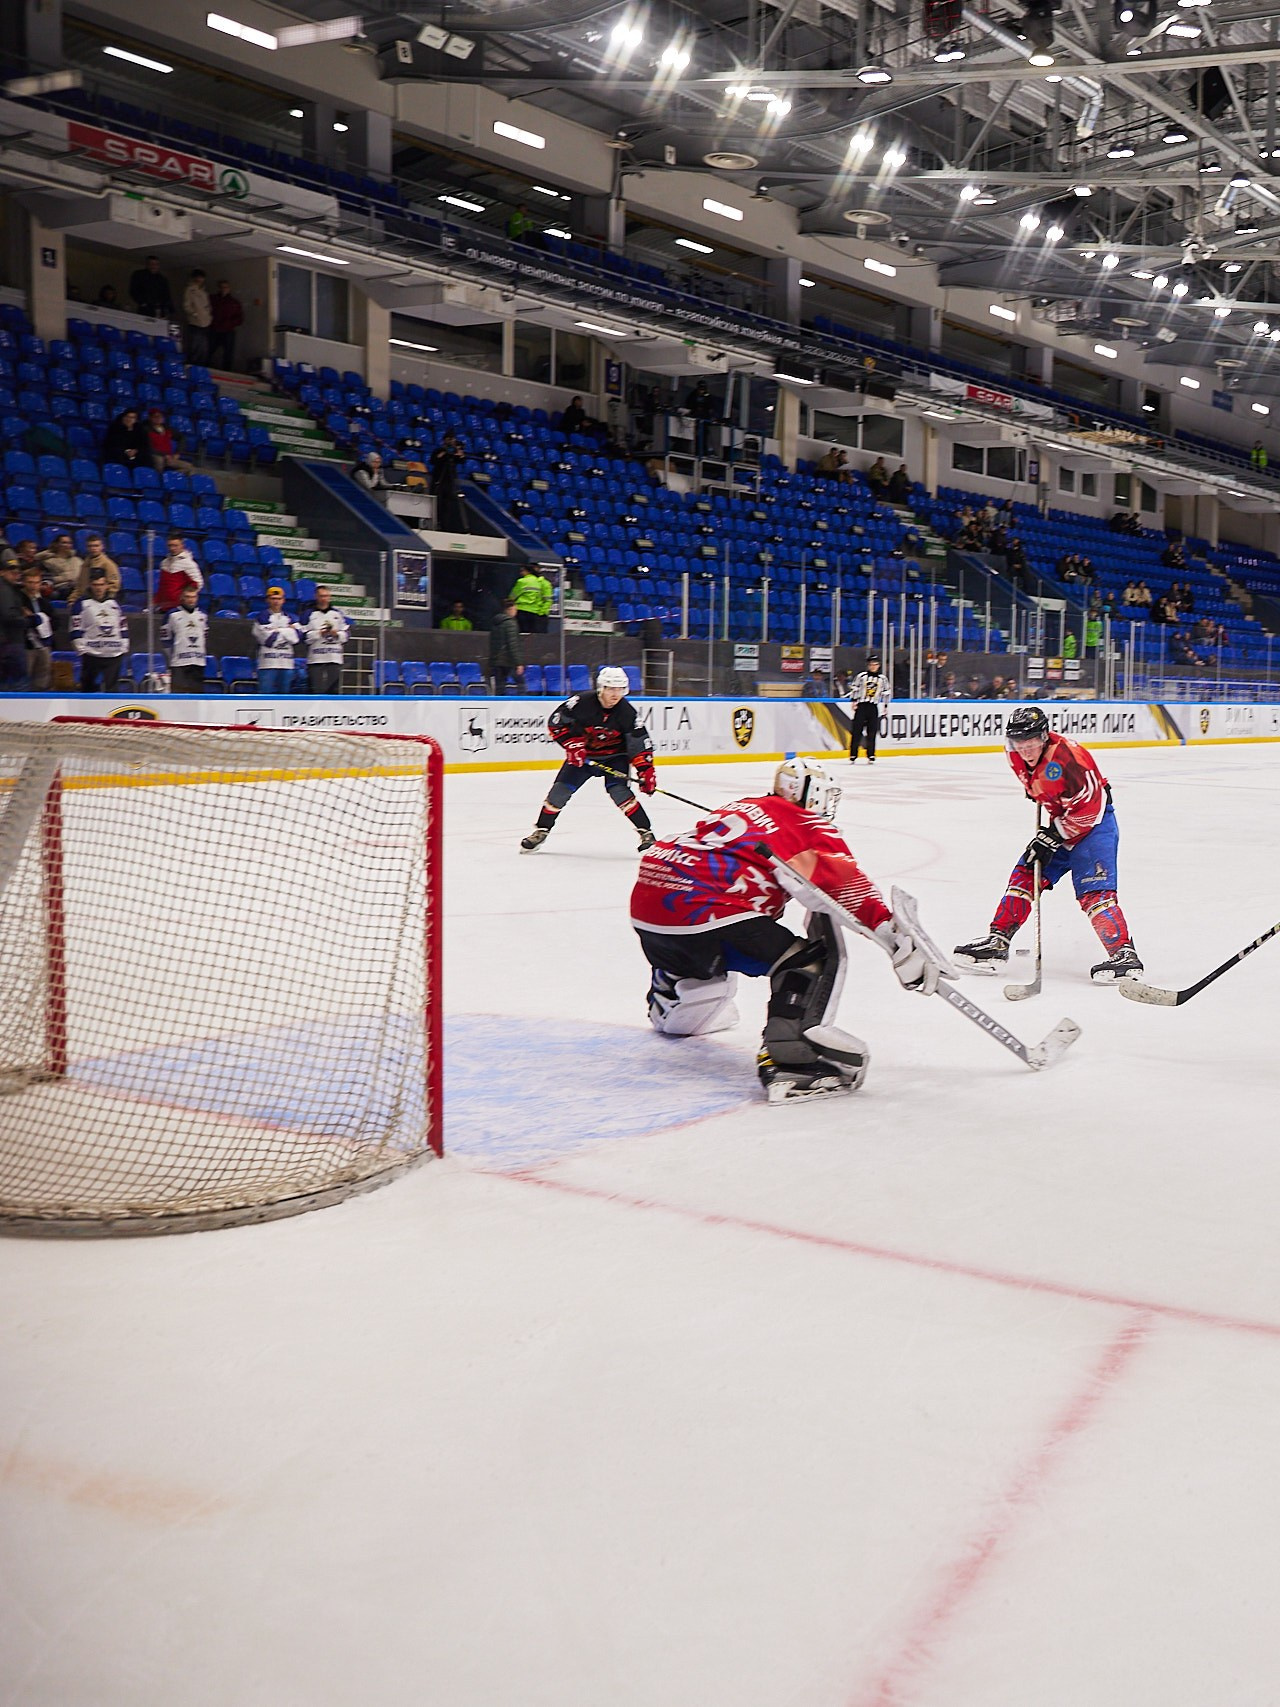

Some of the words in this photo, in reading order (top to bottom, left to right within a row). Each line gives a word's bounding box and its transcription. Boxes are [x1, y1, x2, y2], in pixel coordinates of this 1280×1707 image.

[103, 138, 215, 185] SPAR
[281, 715, 388, 727] ПРАВИТЕЛЬСТВО
[494, 715, 545, 729] НИЖНИЙ
[878, 713, 1003, 739] ОФИЦЕРСКАЯ
[1102, 713, 1136, 733] ЛИГА
[948, 991, 1022, 1053] BAUER
